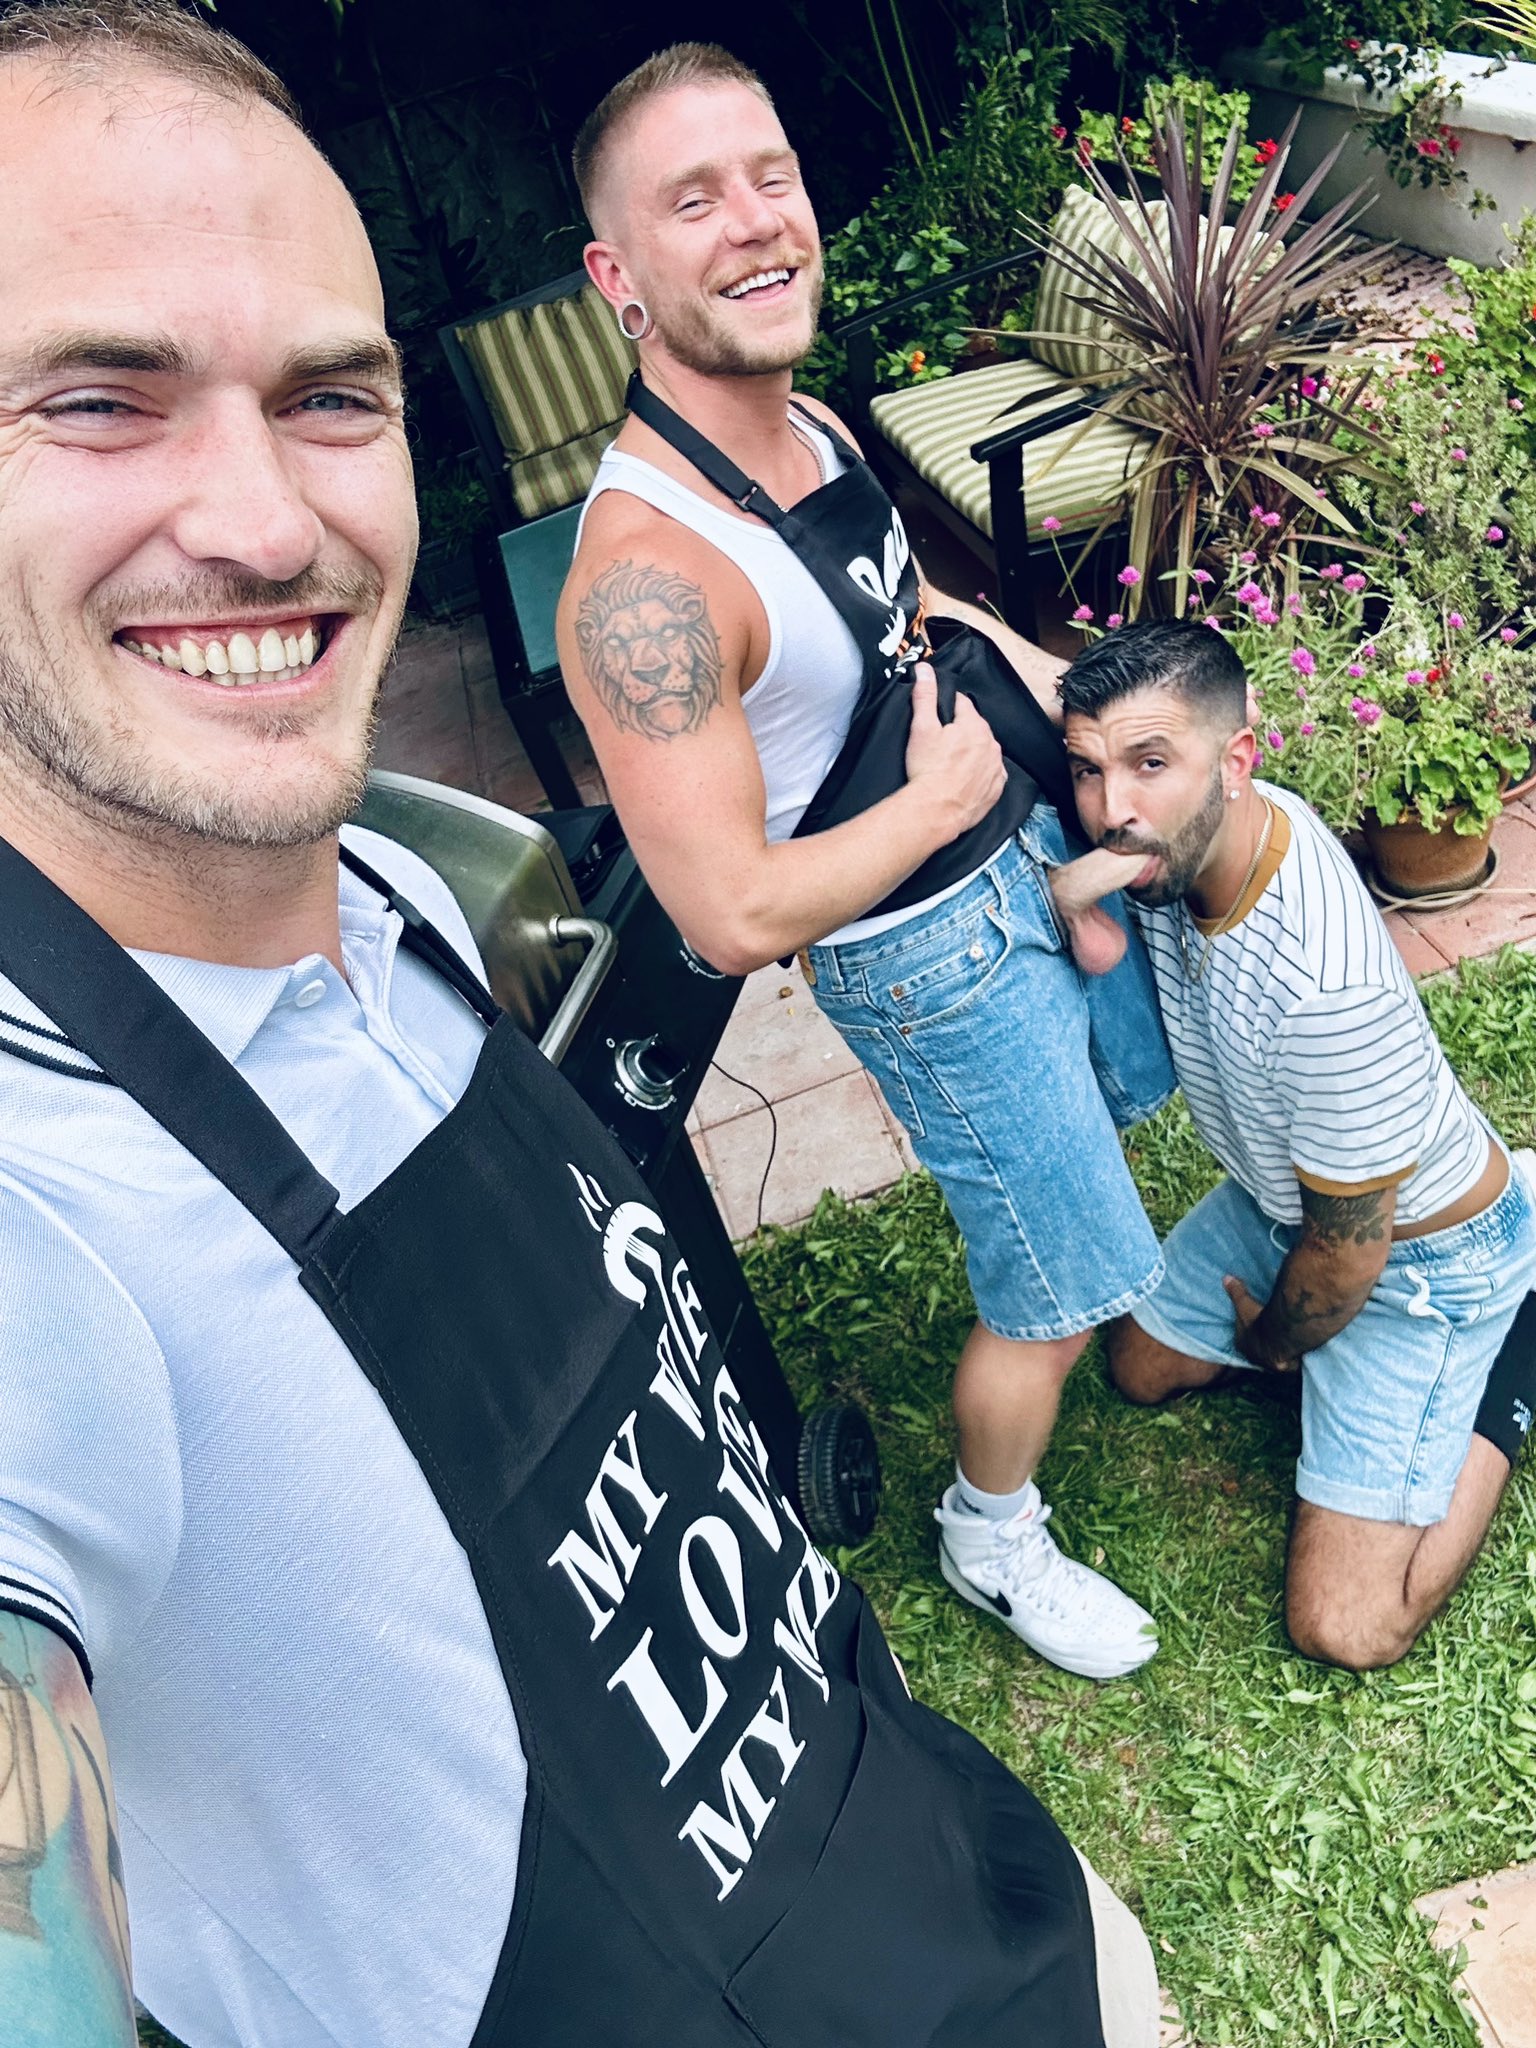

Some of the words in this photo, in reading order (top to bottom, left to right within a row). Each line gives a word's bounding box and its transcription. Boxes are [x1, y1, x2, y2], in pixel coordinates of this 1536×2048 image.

[546, 1409, 669, 1642] MY
[648, 1257, 710, 1442] WIF
[606, 1364, 784, 1788] LOVE
[677, 1665, 806, 1902] MY
